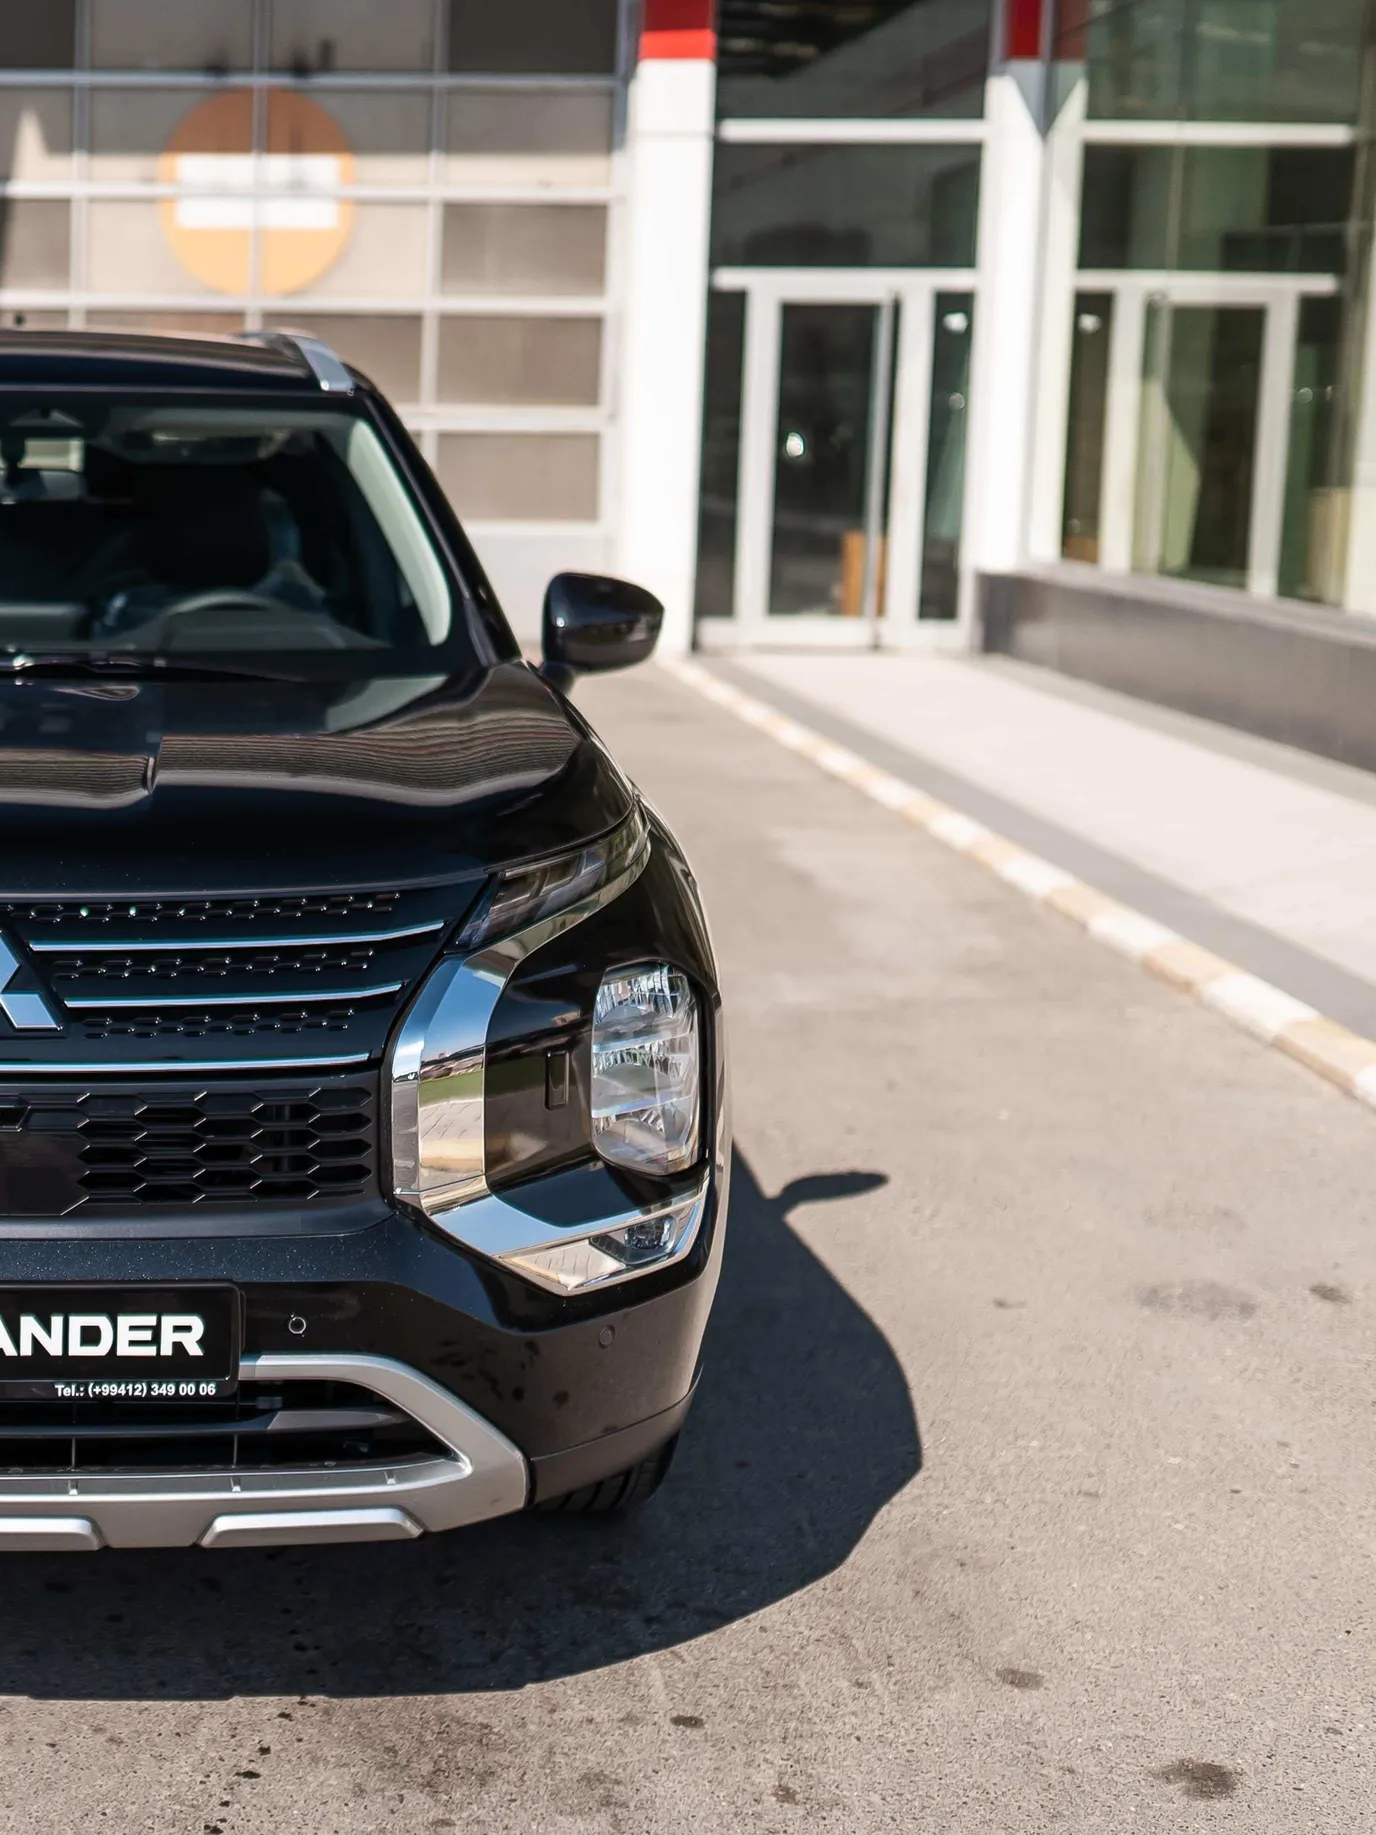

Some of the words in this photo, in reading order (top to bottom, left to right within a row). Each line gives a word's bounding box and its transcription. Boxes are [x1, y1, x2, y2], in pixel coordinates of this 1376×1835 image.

[54, 1384, 85, 1397] Tel.:
[87, 1382, 147, 1398] (+99412)
[150, 1383, 175, 1396] 349
[178, 1383, 195, 1396] 00
[198, 1382, 216, 1396] 06
